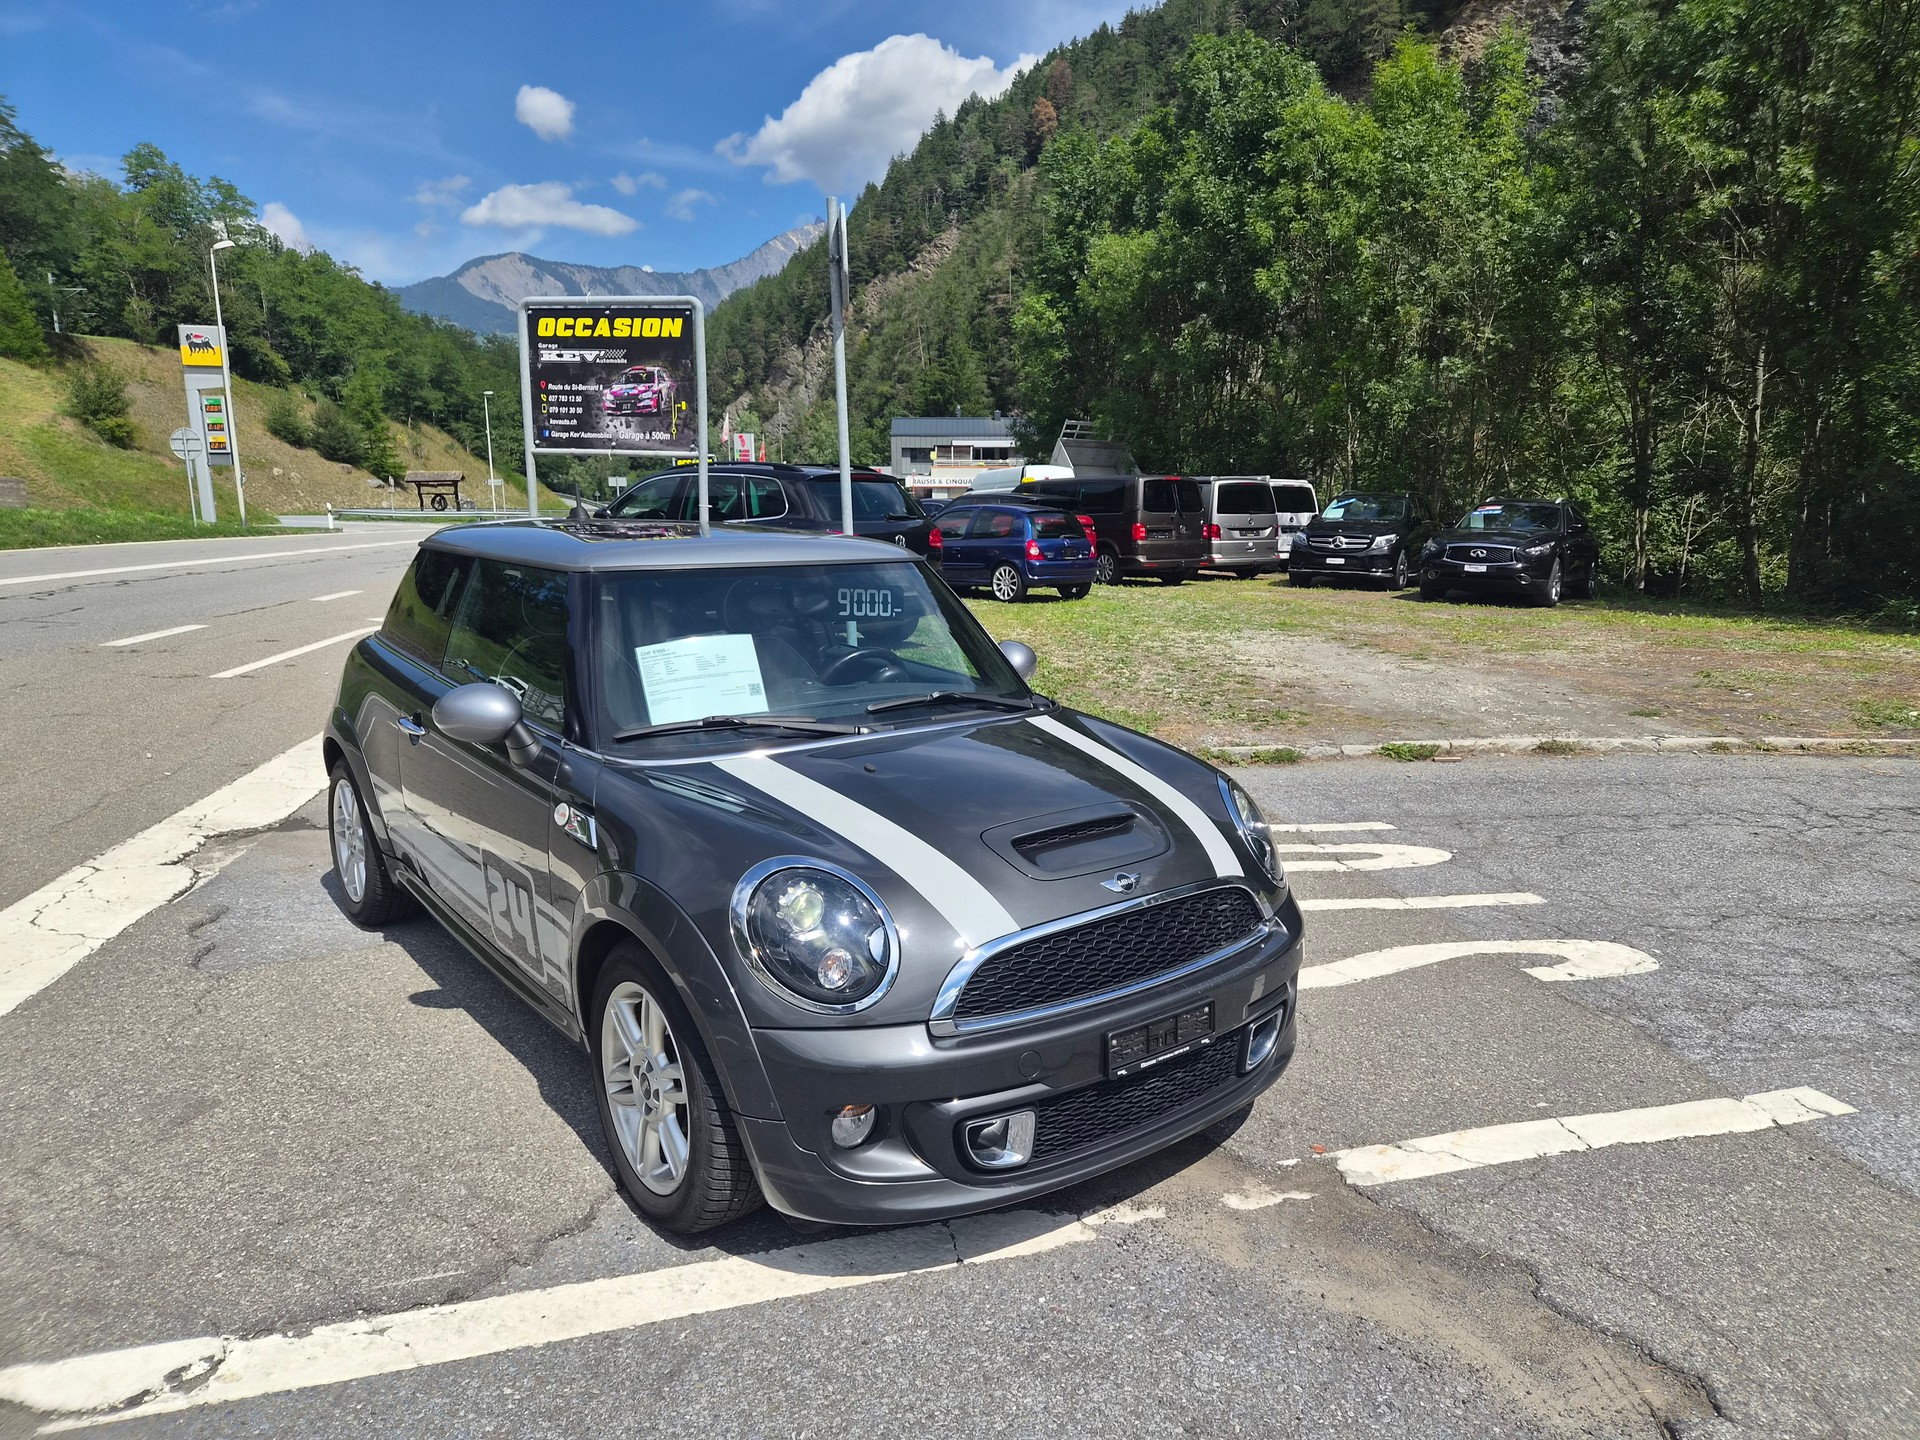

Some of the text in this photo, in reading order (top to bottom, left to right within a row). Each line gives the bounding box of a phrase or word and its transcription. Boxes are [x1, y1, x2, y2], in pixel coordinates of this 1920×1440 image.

[537, 318, 683, 337] OCCASION
[551, 430, 612, 439] Garage Kev'Automobiles
[619, 431, 671, 441] Garage à 500m
[487, 865, 536, 958] 24
